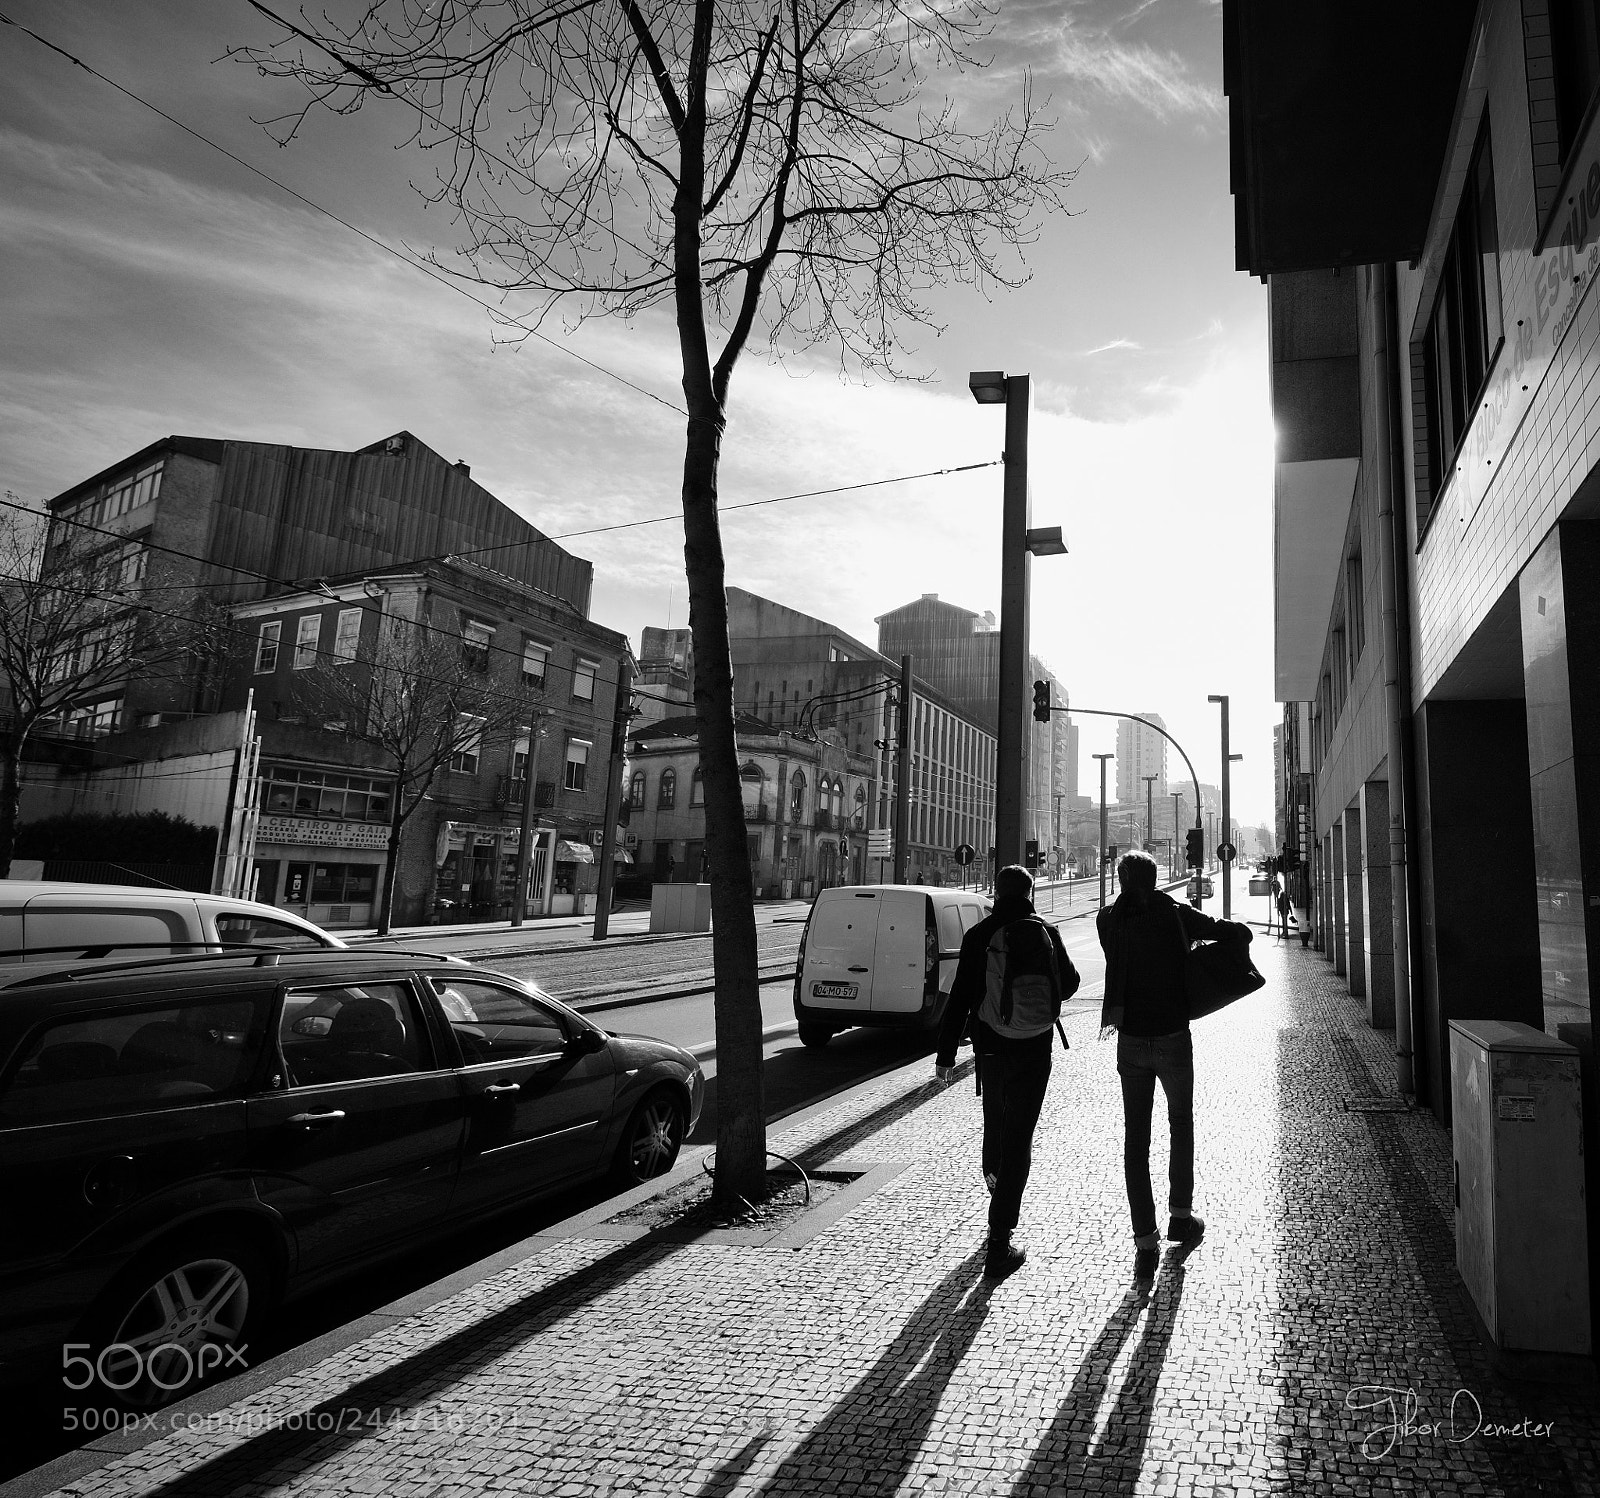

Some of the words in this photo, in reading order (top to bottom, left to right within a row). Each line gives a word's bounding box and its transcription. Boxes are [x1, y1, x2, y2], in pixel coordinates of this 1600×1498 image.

[1476, 367, 1511, 469] Bloco
[1513, 317, 1533, 383] de
[258, 825, 299, 833] ERCEARIA
[269, 817, 330, 831] CELEIRO
[336, 823, 353, 832] DE
[359, 825, 387, 834] GAIA
[257, 831, 298, 839] RODUTOS
